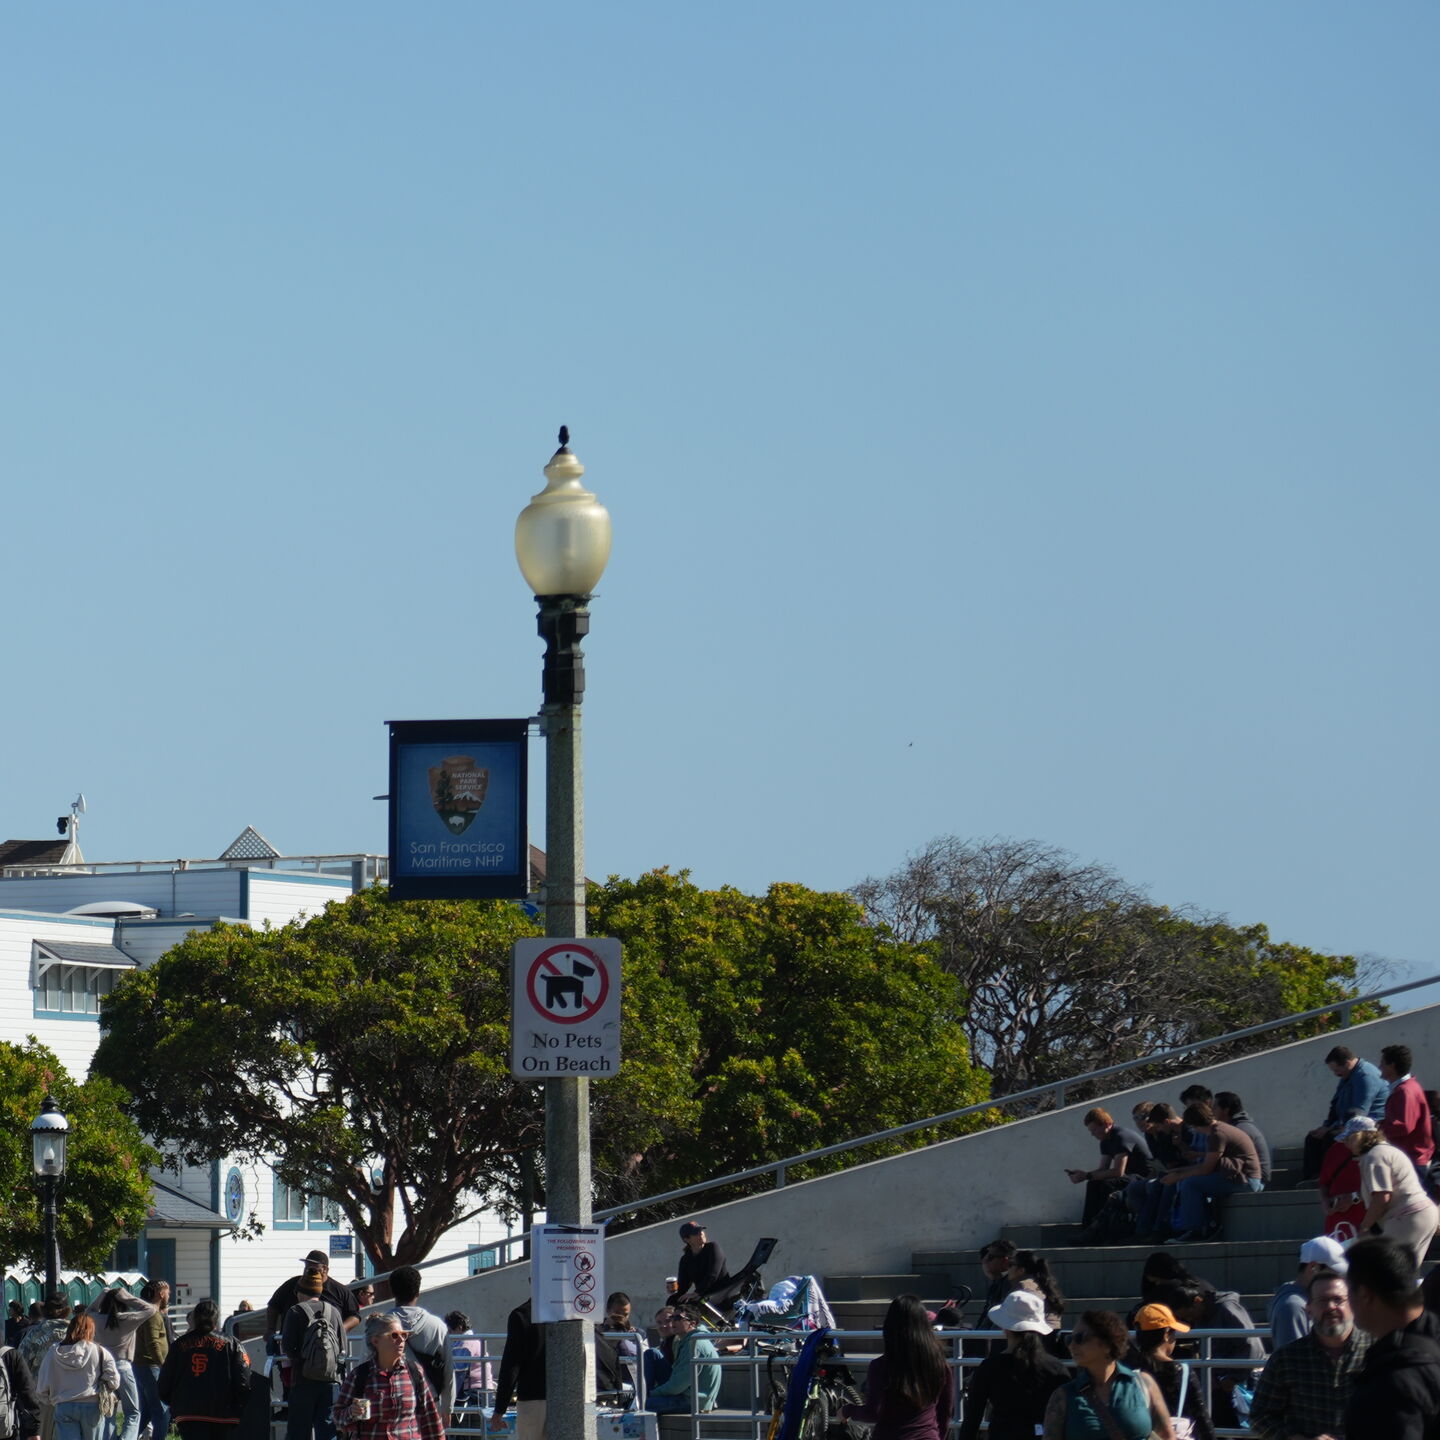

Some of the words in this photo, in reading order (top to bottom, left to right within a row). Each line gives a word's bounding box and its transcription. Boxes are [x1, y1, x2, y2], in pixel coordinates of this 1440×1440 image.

[410, 842, 435, 854] San
[440, 842, 505, 853] Francisco
[411, 857, 471, 868] Maritime
[475, 856, 504, 867] NHP
[532, 1033, 559, 1048] No
[565, 1033, 602, 1048] Pets
[522, 1056, 549, 1071] On
[556, 1056, 610, 1071] Beach
